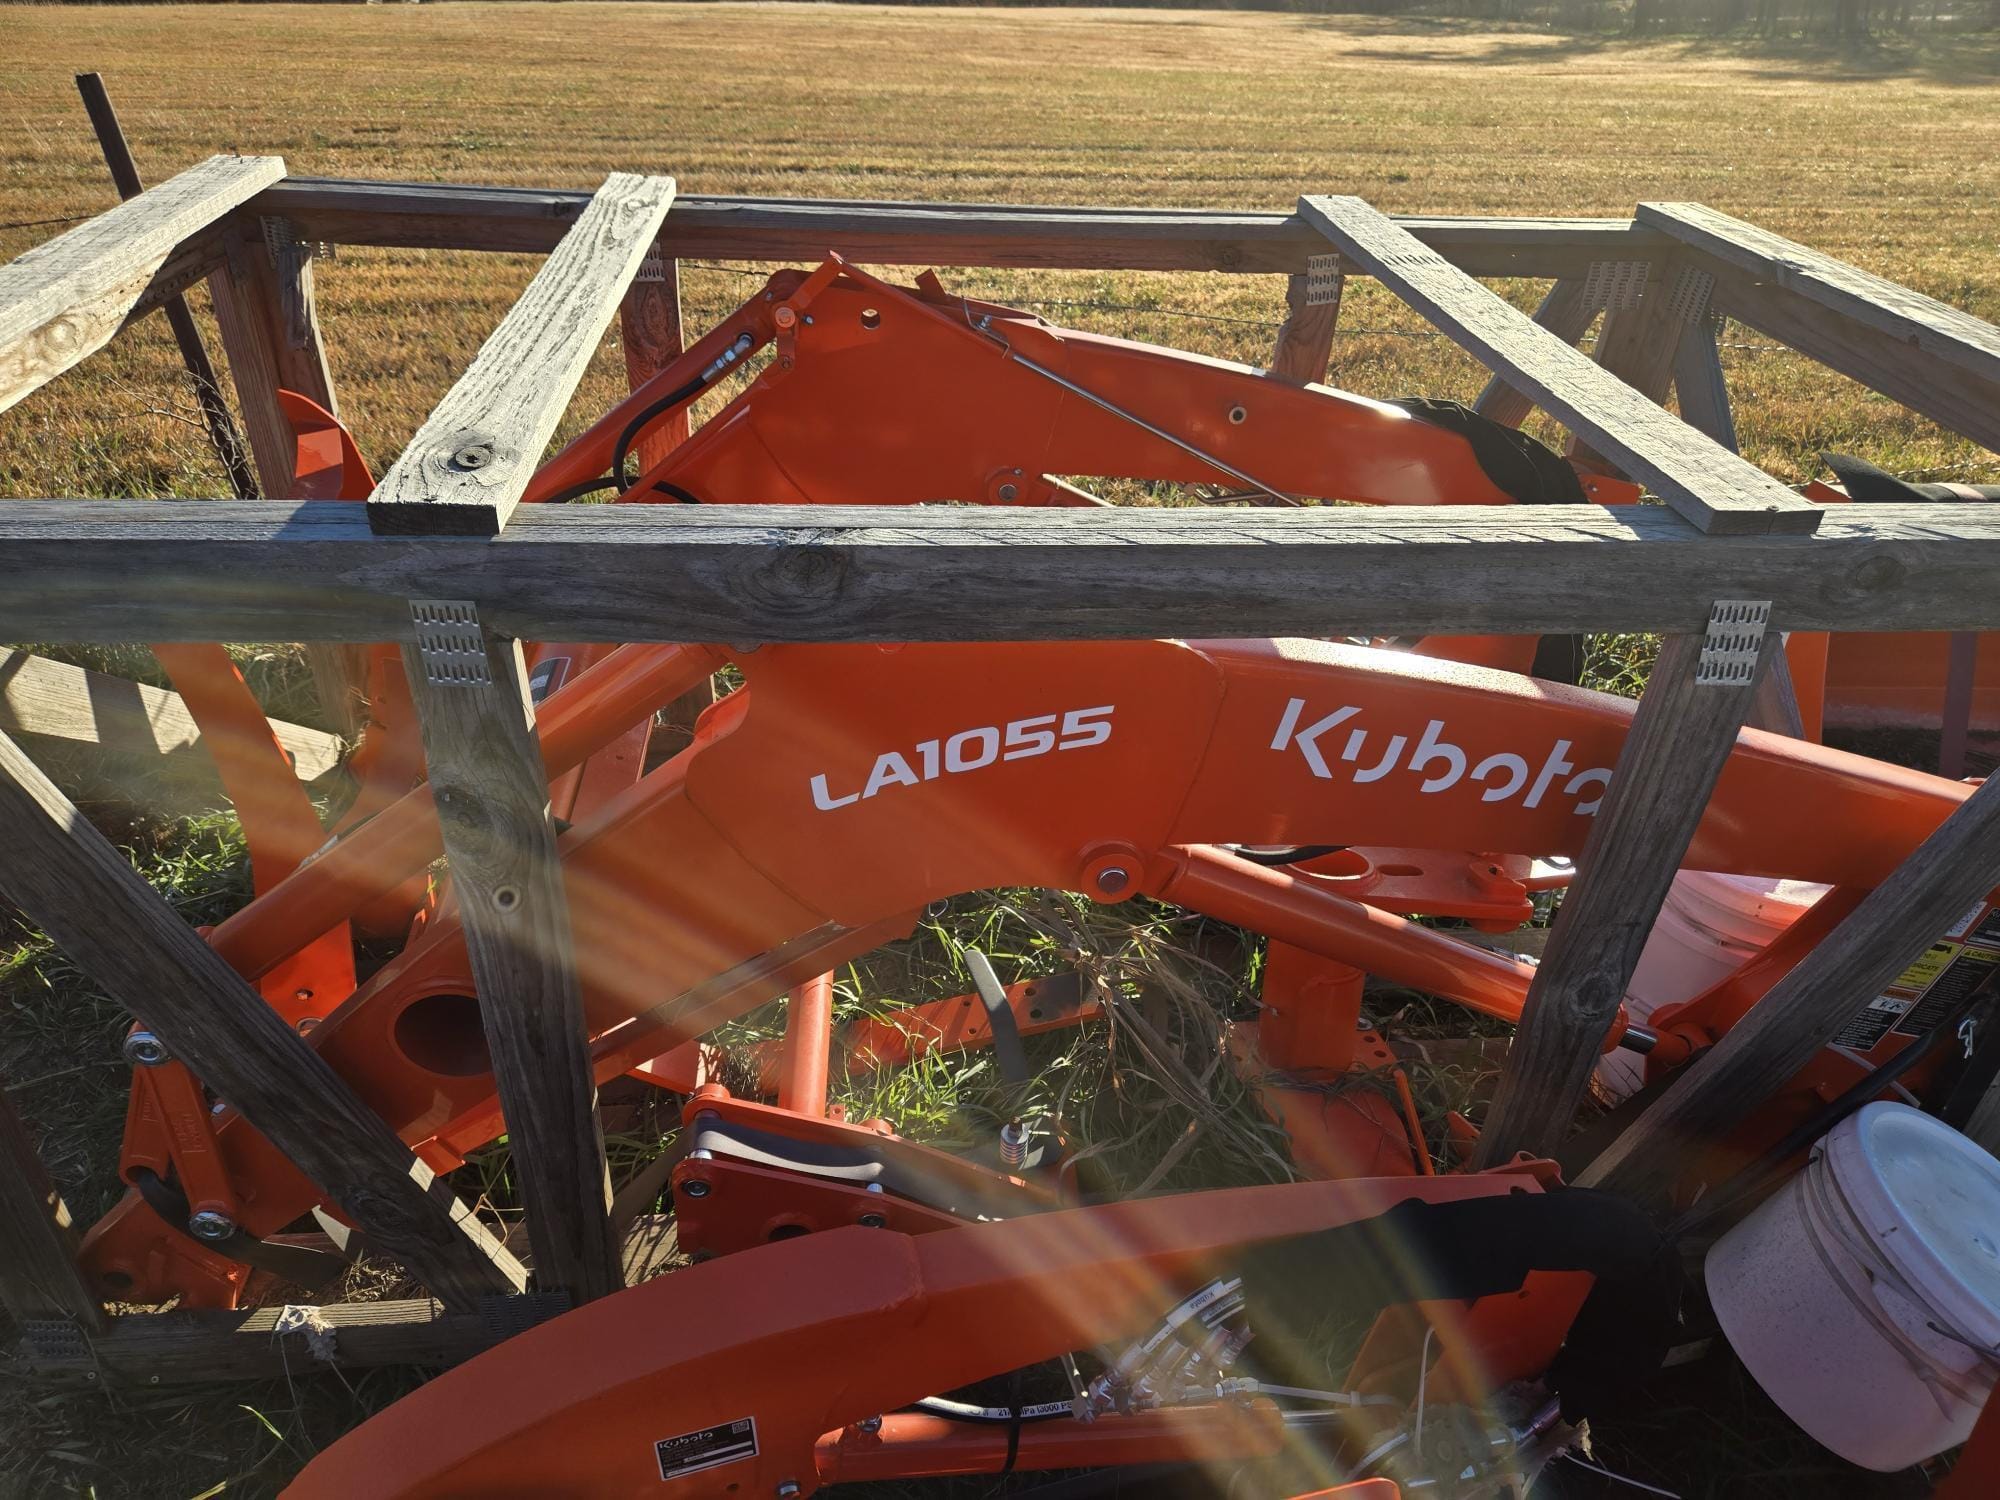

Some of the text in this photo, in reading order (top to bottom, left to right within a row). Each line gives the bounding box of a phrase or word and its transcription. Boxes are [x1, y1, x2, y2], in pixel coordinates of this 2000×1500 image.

[810, 704, 1115, 811] LA1055
[1271, 697, 1613, 817] Kubota
[659, 1431, 713, 1449] Kubota
